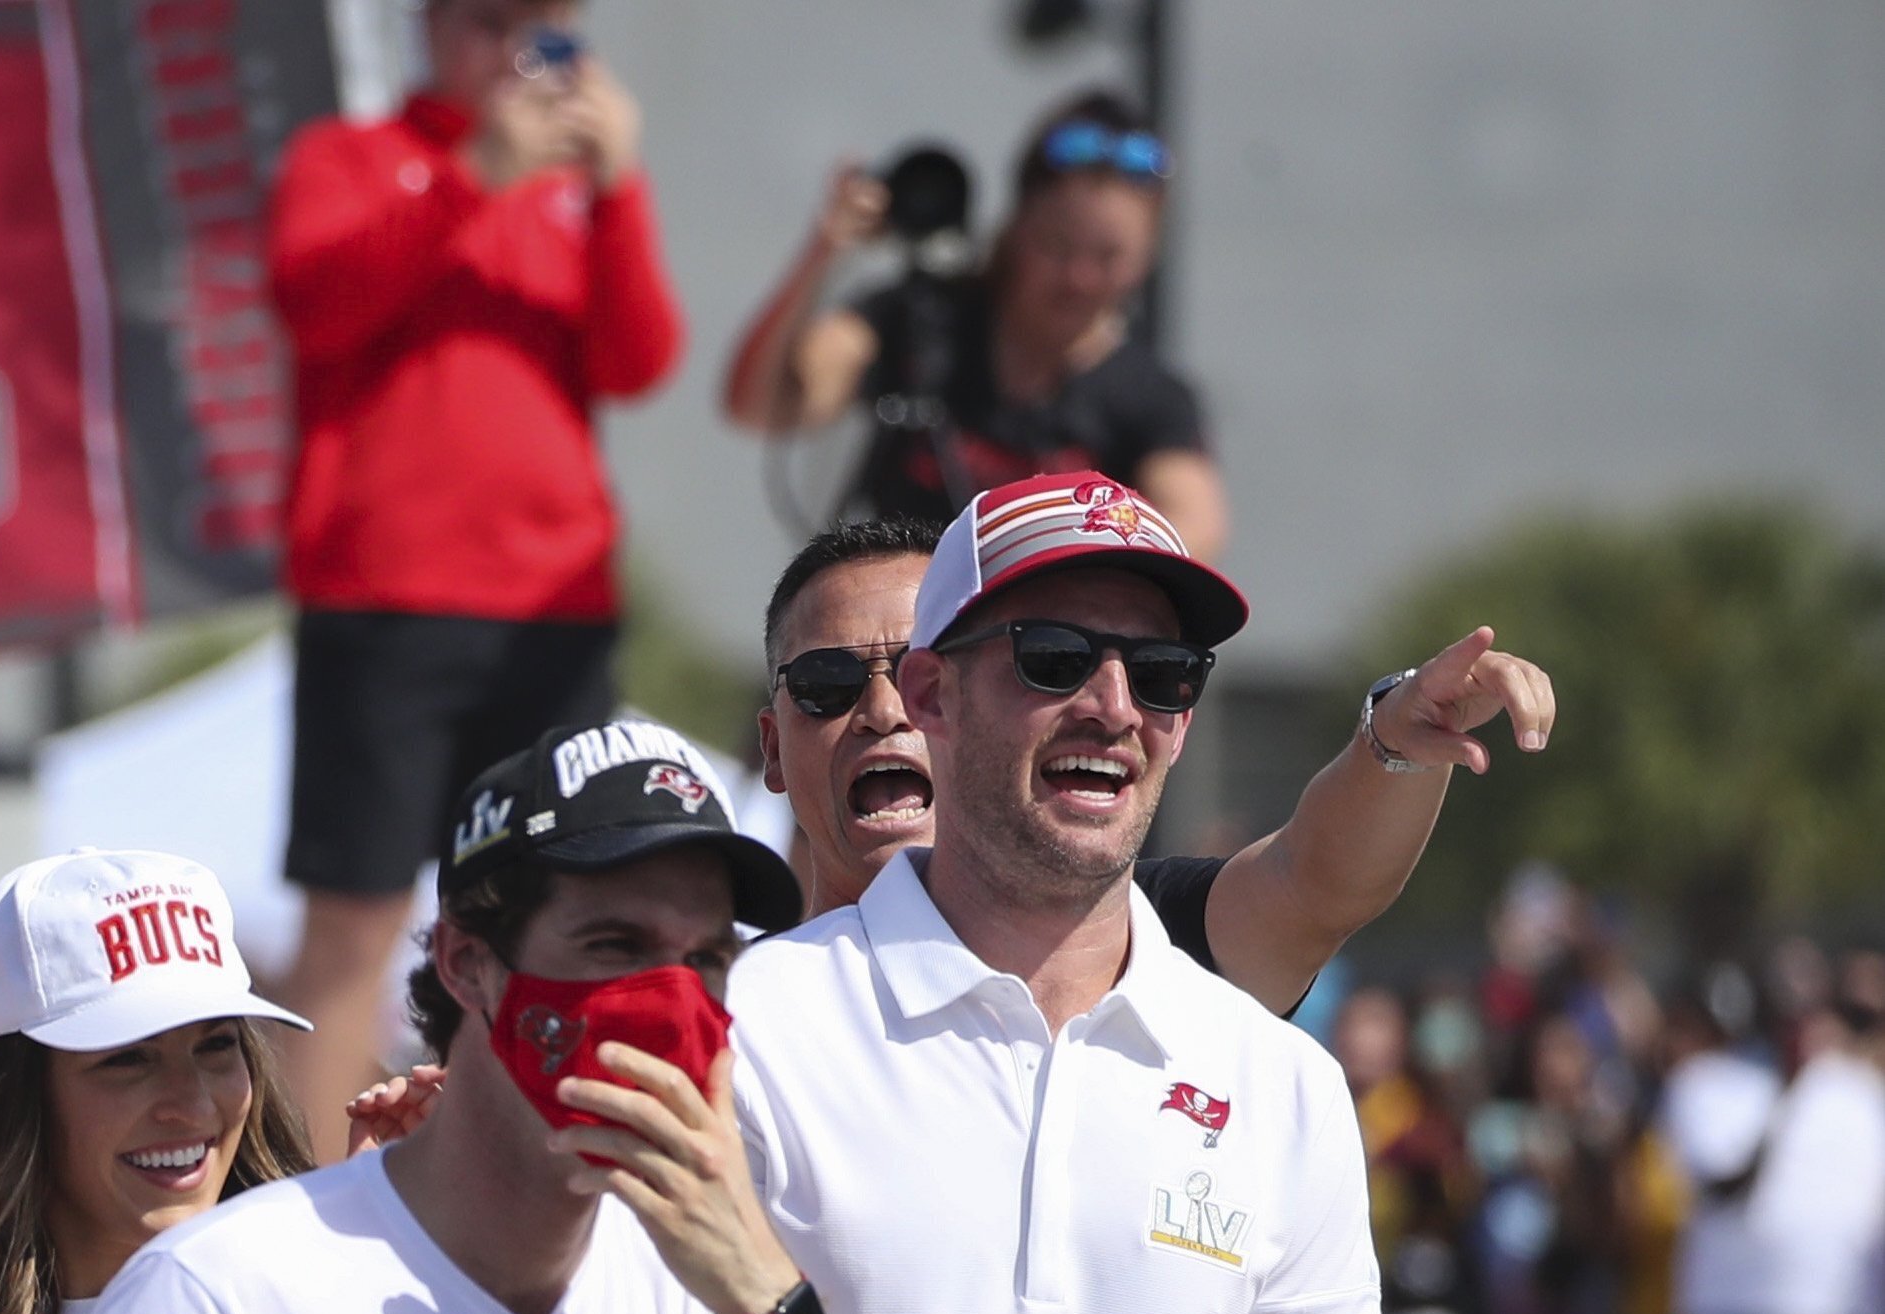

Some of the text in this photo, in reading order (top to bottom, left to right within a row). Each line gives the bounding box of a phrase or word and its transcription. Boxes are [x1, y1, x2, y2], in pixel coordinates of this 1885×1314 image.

[104, 883, 194, 907] TAMPA BAY
[95, 900, 223, 984] BUCS
